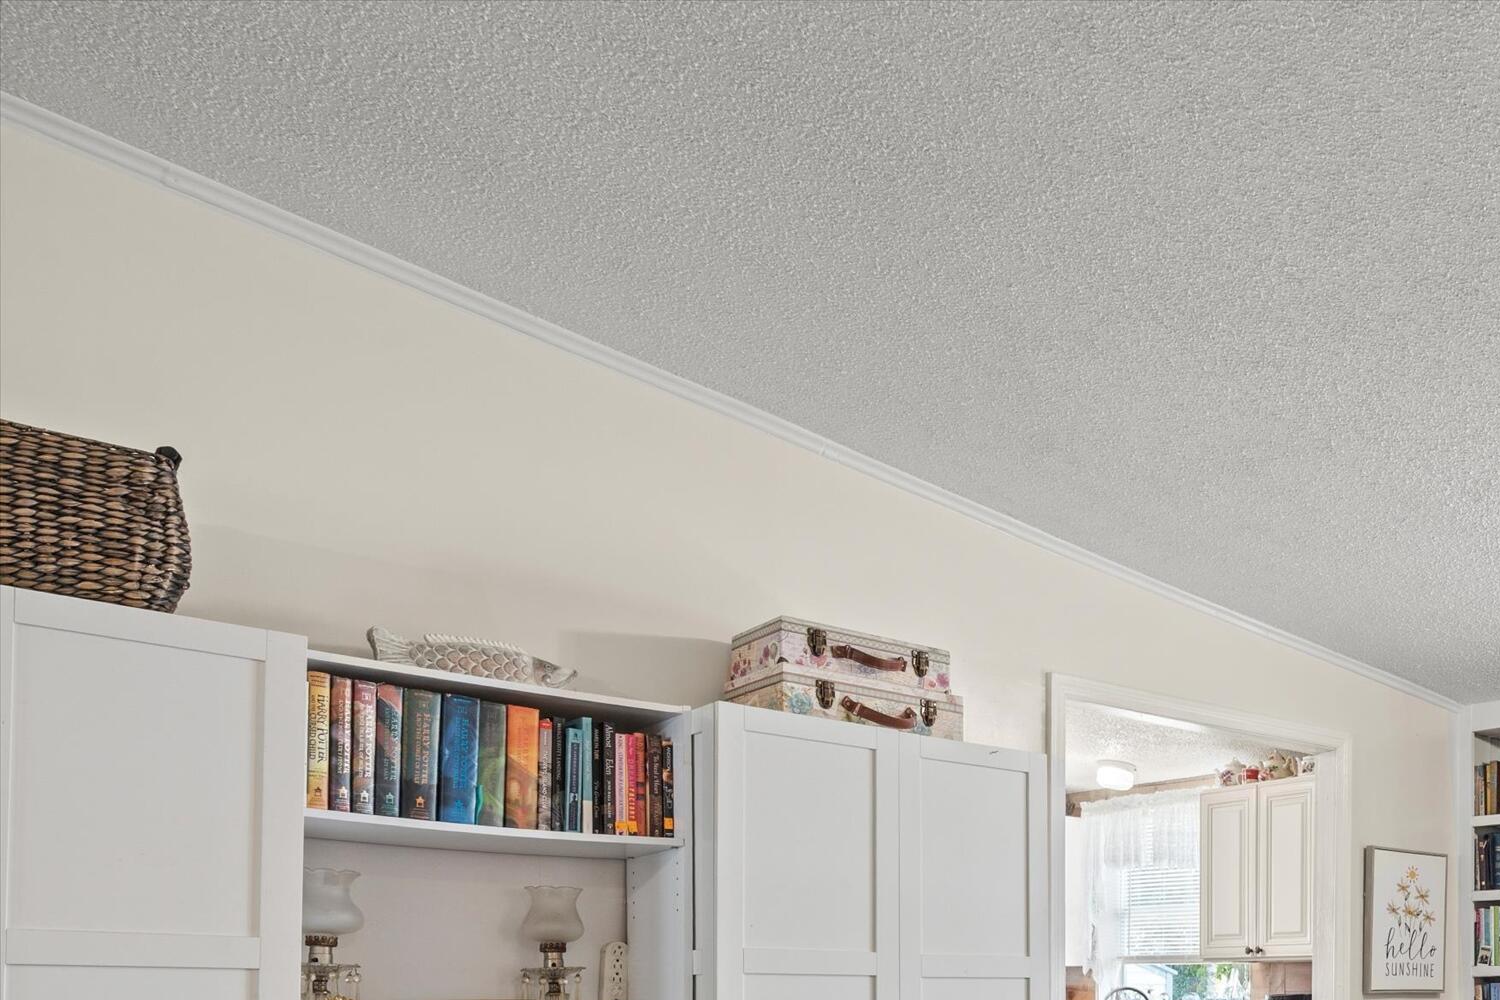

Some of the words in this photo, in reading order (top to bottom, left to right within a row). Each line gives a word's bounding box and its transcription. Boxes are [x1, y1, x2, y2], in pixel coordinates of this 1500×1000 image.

[317, 694, 328, 725] HARRY
[364, 704, 374, 739] HARRY
[317, 728, 328, 763] POTTER
[421, 712, 431, 746] HARRY
[605, 724, 613, 747] Almost
[364, 742, 373, 778] POTTER
[421, 751, 431, 784] POTTER
[1384, 927, 1437, 960] hello
[1385, 962, 1435, 978] SUNSHINE
